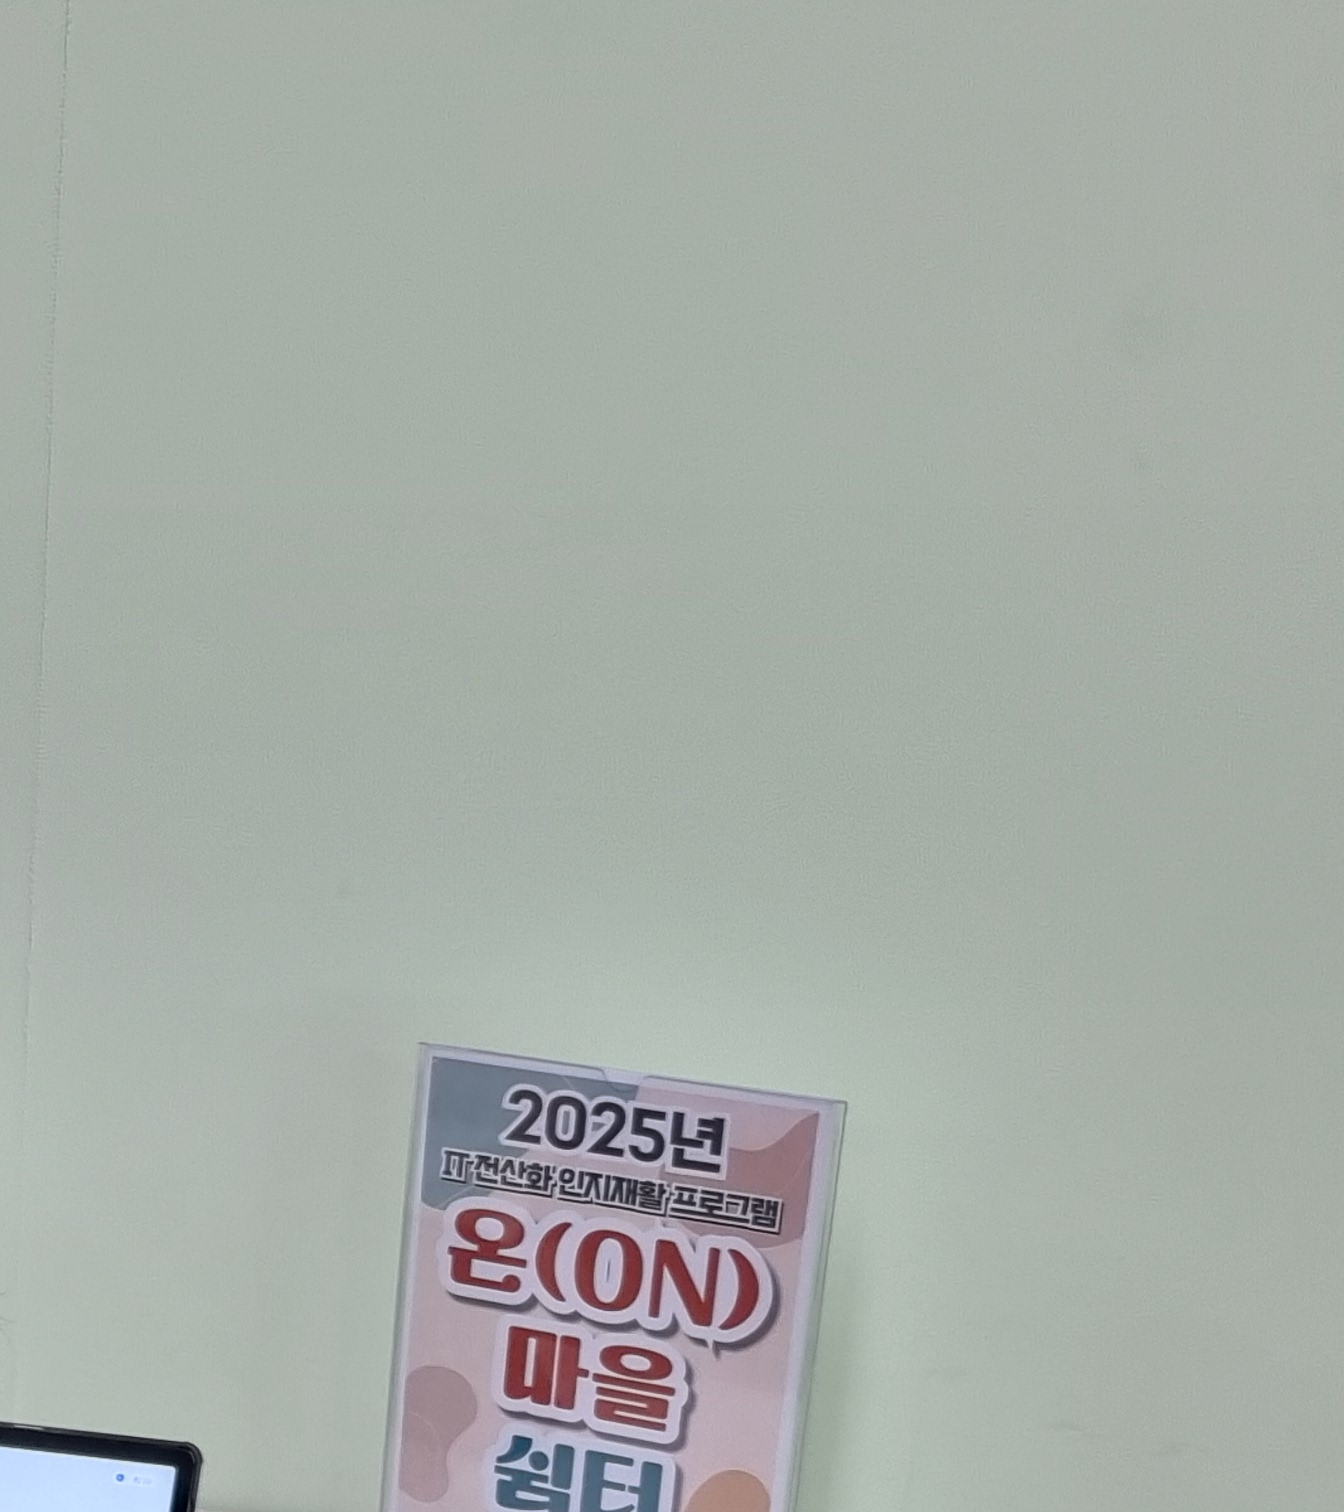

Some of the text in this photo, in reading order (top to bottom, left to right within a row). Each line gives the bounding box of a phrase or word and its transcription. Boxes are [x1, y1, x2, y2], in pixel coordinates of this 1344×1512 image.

[504, 1088, 724, 1173] 2025년
[473, 1153, 554, 1194] 전산화
[557, 1165, 666, 1216] 인지재활
[671, 1184, 780, 1231] 프로그램
[448, 1207, 761, 1332] 온(ON)
[502, 1324, 678, 1433] 마을
